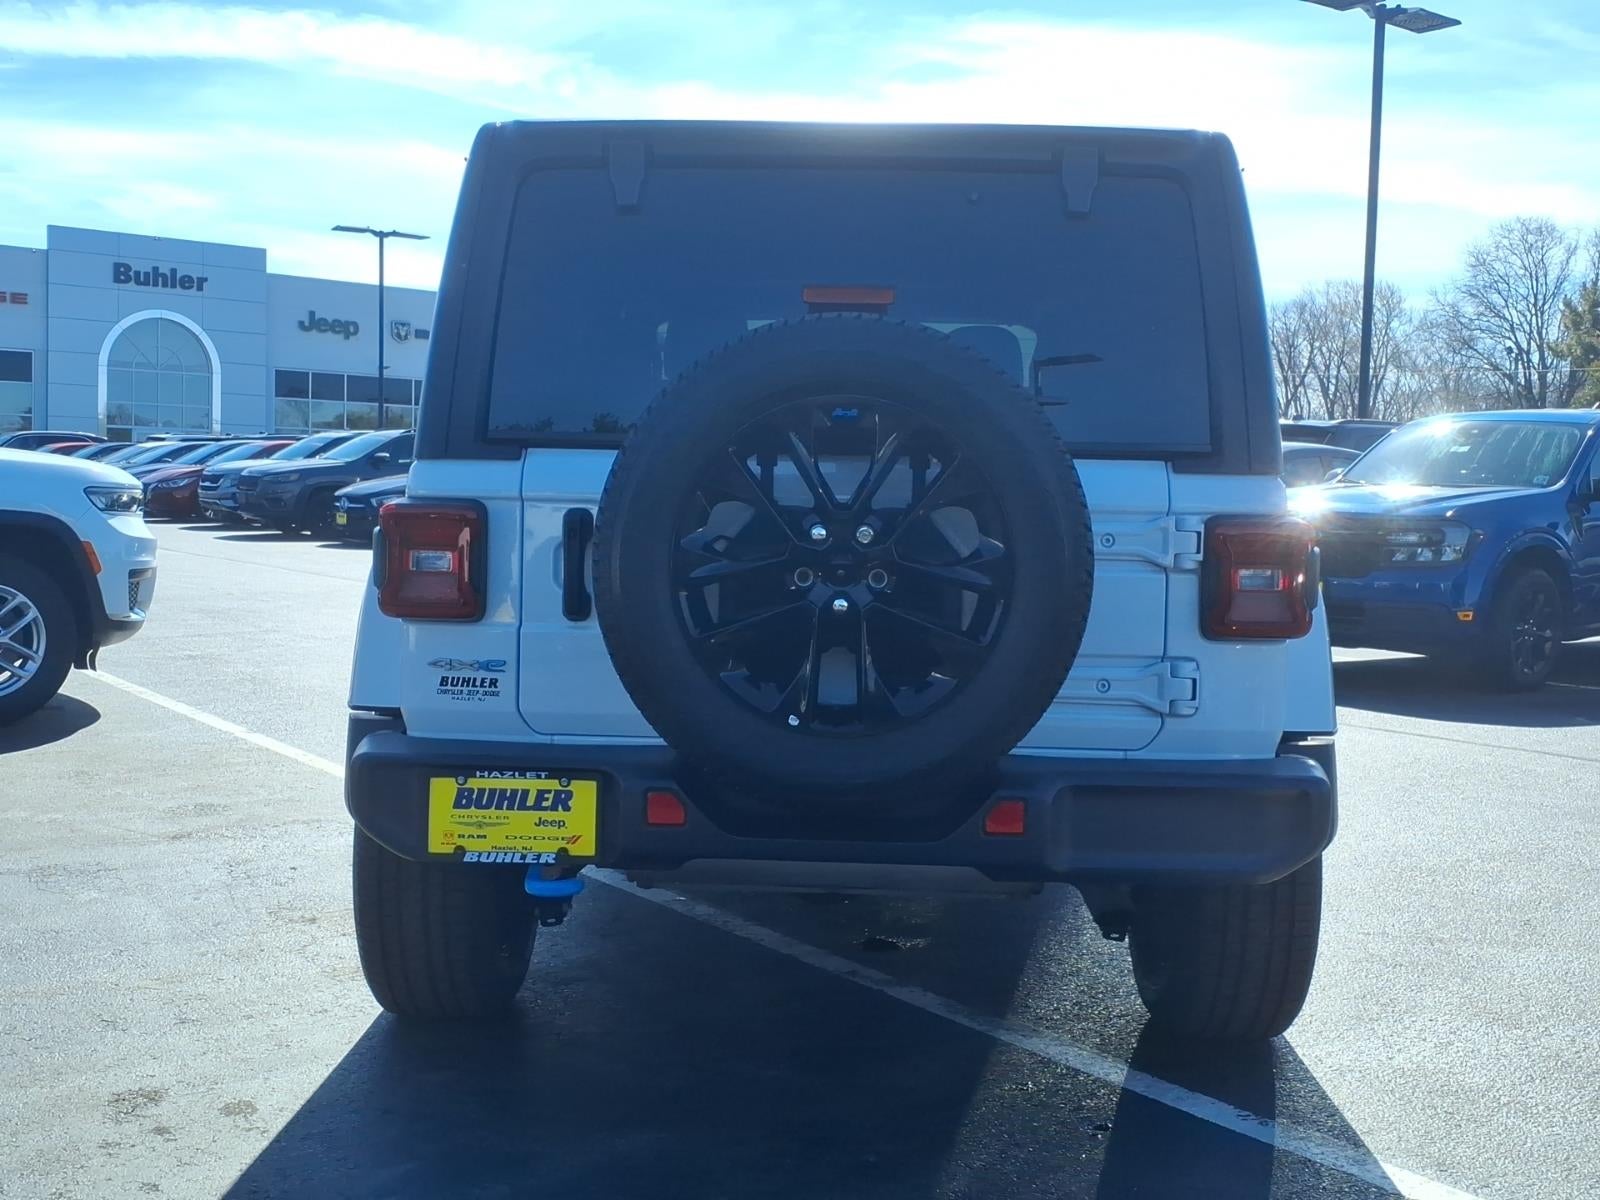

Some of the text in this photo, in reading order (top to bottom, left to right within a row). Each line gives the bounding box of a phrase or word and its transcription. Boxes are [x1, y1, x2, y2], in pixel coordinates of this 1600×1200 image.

[112, 262, 208, 292] Buhler
[297, 310, 359, 340] Jeep
[439, 676, 499, 688] BUHLER
[475, 770, 549, 779] HAZLET
[452, 786, 574, 812] BUHLER
[463, 851, 556, 863] BUHLER
